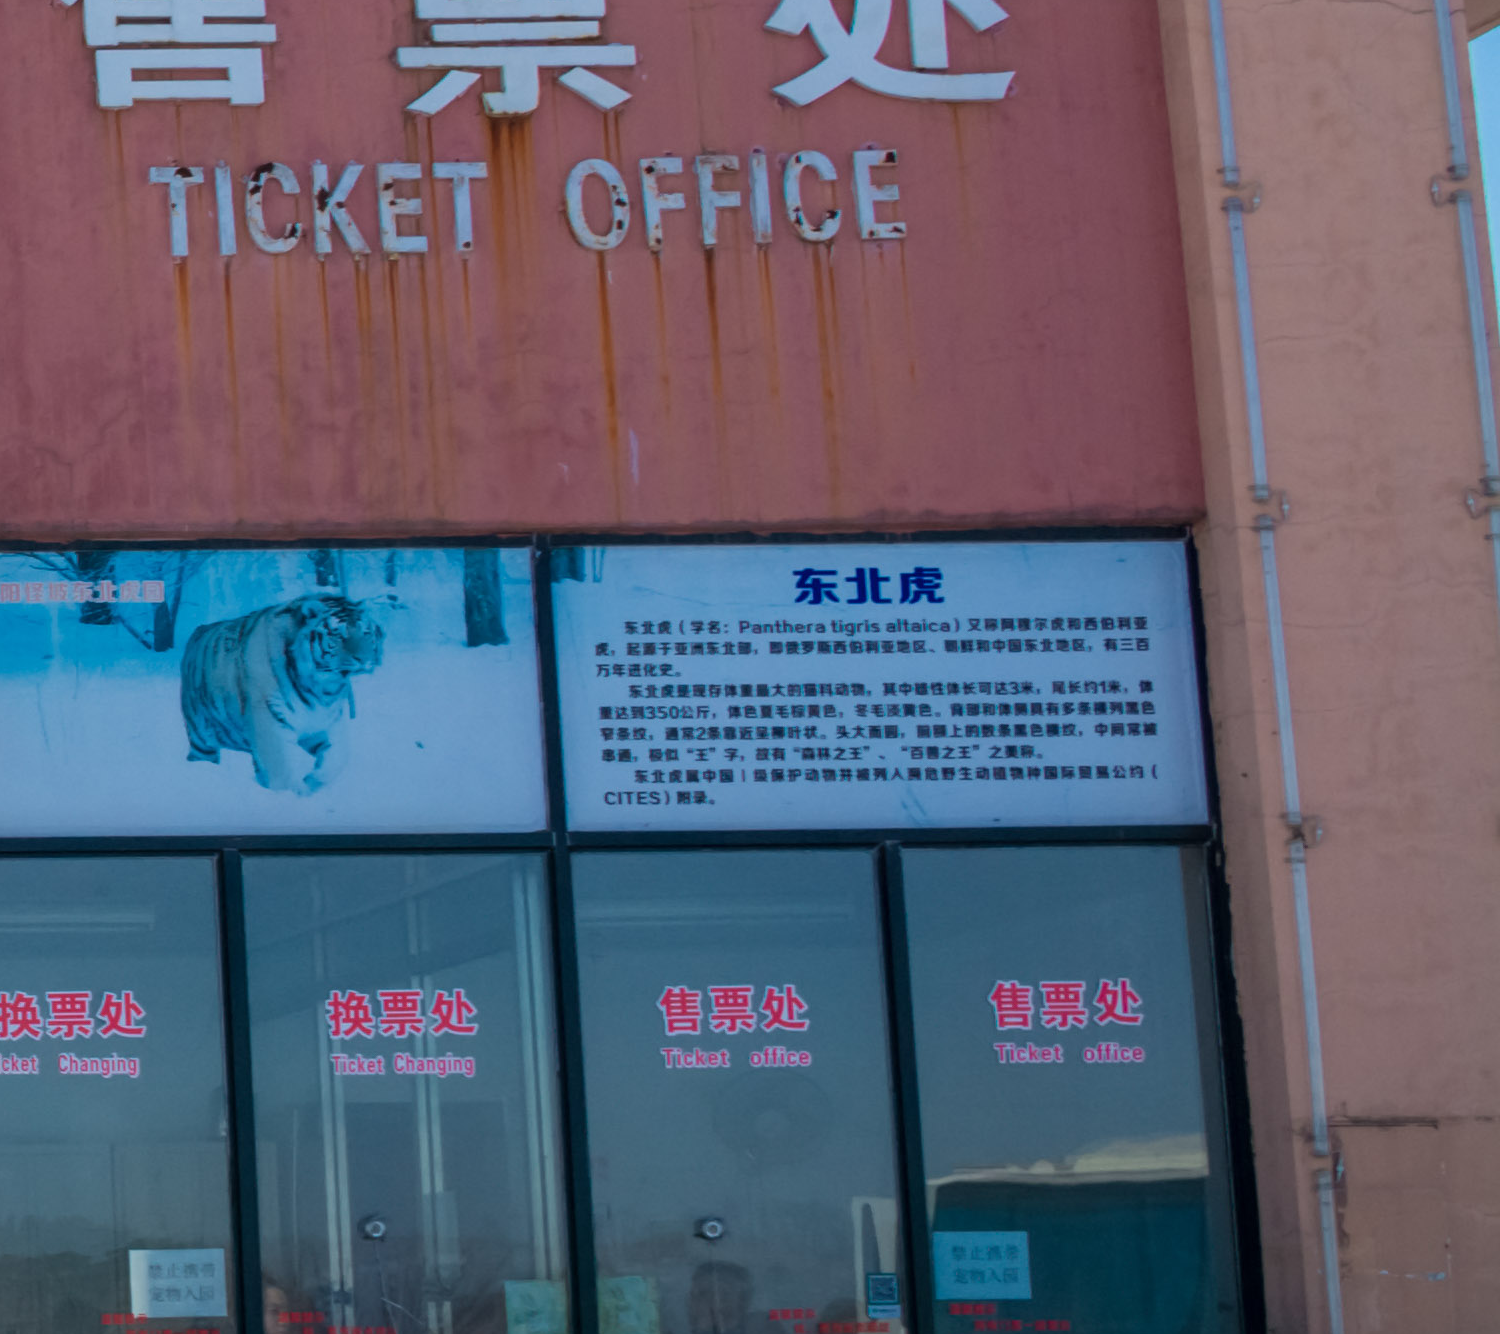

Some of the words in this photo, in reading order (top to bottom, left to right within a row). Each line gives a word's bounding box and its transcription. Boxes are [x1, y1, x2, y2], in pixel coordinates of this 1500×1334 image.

[149, 159, 489, 261] TICKET
[565, 149, 908, 253] OFFICE
[793, 567, 945, 605] 东北虎
[831, 618, 881, 637] tigris
[327, 989, 478, 1039] 换票处
[657, 984, 810, 1035] 售票处
[989, 979, 1145, 1031] 售票处
[58, 1053, 140, 1078] Changing
[330, 1054, 385, 1075] Ticket
[393, 1052, 476, 1077] Changing
[661, 1048, 730, 1068] Ticket
[749, 1046, 812, 1067] office
[993, 1042, 1064, 1063] Ticket
[1083, 1042, 1145, 1063] office
